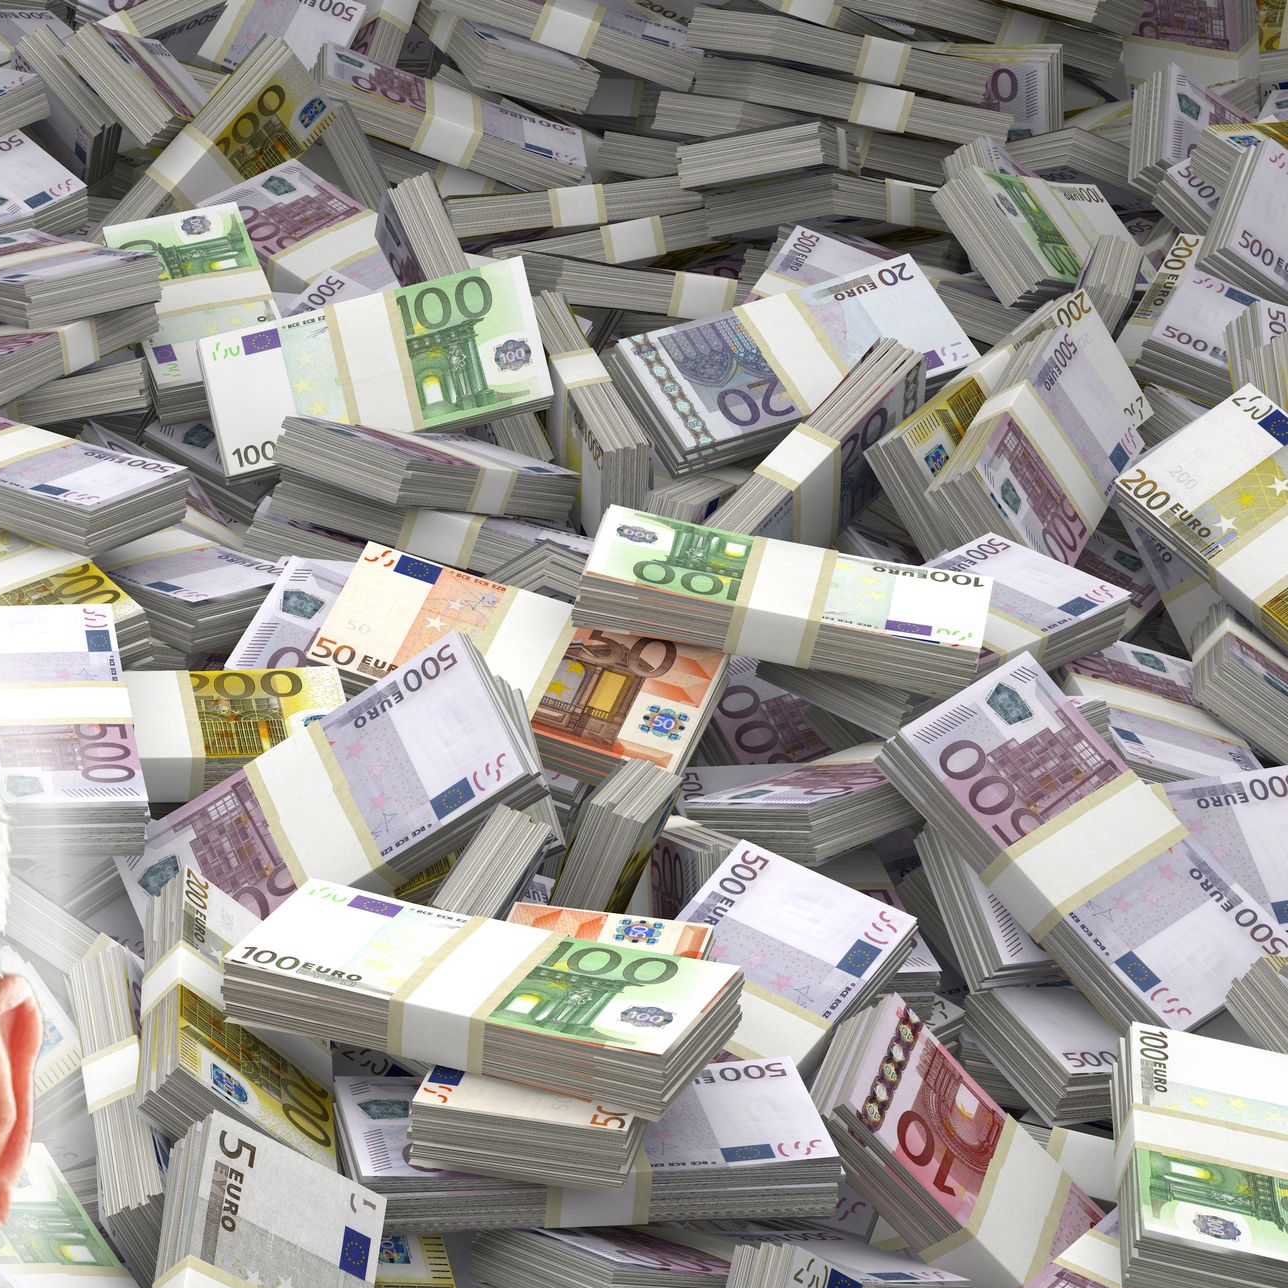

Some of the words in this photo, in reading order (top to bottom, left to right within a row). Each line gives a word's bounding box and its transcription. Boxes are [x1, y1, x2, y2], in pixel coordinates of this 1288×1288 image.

[1165, 235, 1200, 270] 200
[1238, 229, 1274, 267] 500
[309, 275, 345, 307] 500
[835, 280, 878, 303] EURO
[877, 264, 914, 288] 20
[1148, 272, 1179, 308] EURO
[396, 276, 492, 326] 100
[1052, 333, 1077, 369] 500
[1161, 325, 1209, 349] 500
[1043, 362, 1066, 392] EURO
[716, 381, 794, 428] 20
[232, 441, 277, 466] 100
[1119, 470, 1169, 512] 200
[1169, 503, 1211, 538] EURO
[454, 572, 471, 581] BCE
[473, 578, 489, 586] ECB
[492, 583, 508, 592] EZB
[872, 566, 930, 578] EURO
[930, 571, 983, 587] 100
[311, 637, 355, 667] 50
[403, 644, 458, 694] 500
[353, 683, 405, 729] EURO
[655, 716, 675, 728] 50
[73, 723, 136, 784] 500
[185, 868, 209, 907] 200
[193, 908, 206, 944] EURO
[241, 946, 300, 972] 100
[300, 962, 362, 982] EURO
[555, 940, 678, 989] 100
[720, 1064, 786, 1081] 500
[1139, 1030, 1168, 1064] 100
[1154, 1066, 1167, 1093] EURO
[220, 1130, 256, 1168] 5
[896, 1109, 957, 1197] 10
[221, 1171, 244, 1234] EURO
